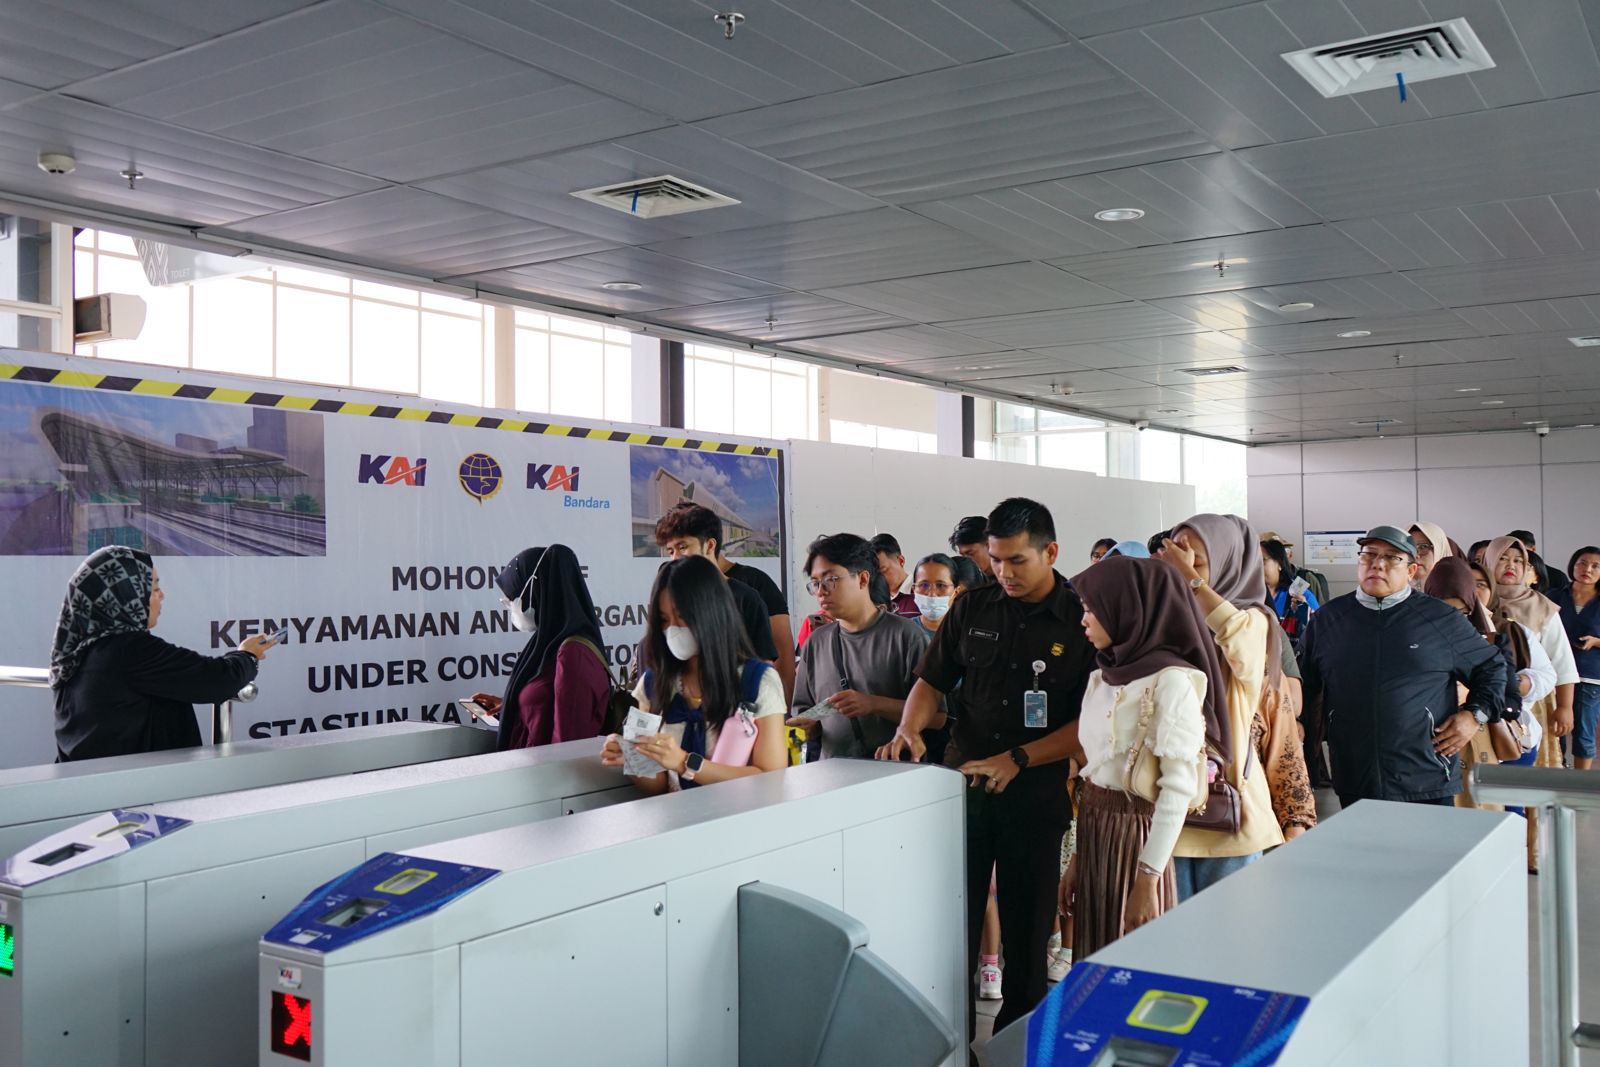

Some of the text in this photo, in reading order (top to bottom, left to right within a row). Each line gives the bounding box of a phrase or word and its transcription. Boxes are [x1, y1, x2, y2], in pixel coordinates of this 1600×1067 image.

[358, 454, 427, 487] KAI
[526, 463, 580, 492] KAI
[564, 495, 610, 509] Bandara
[308, 659, 429, 693] UNDER
